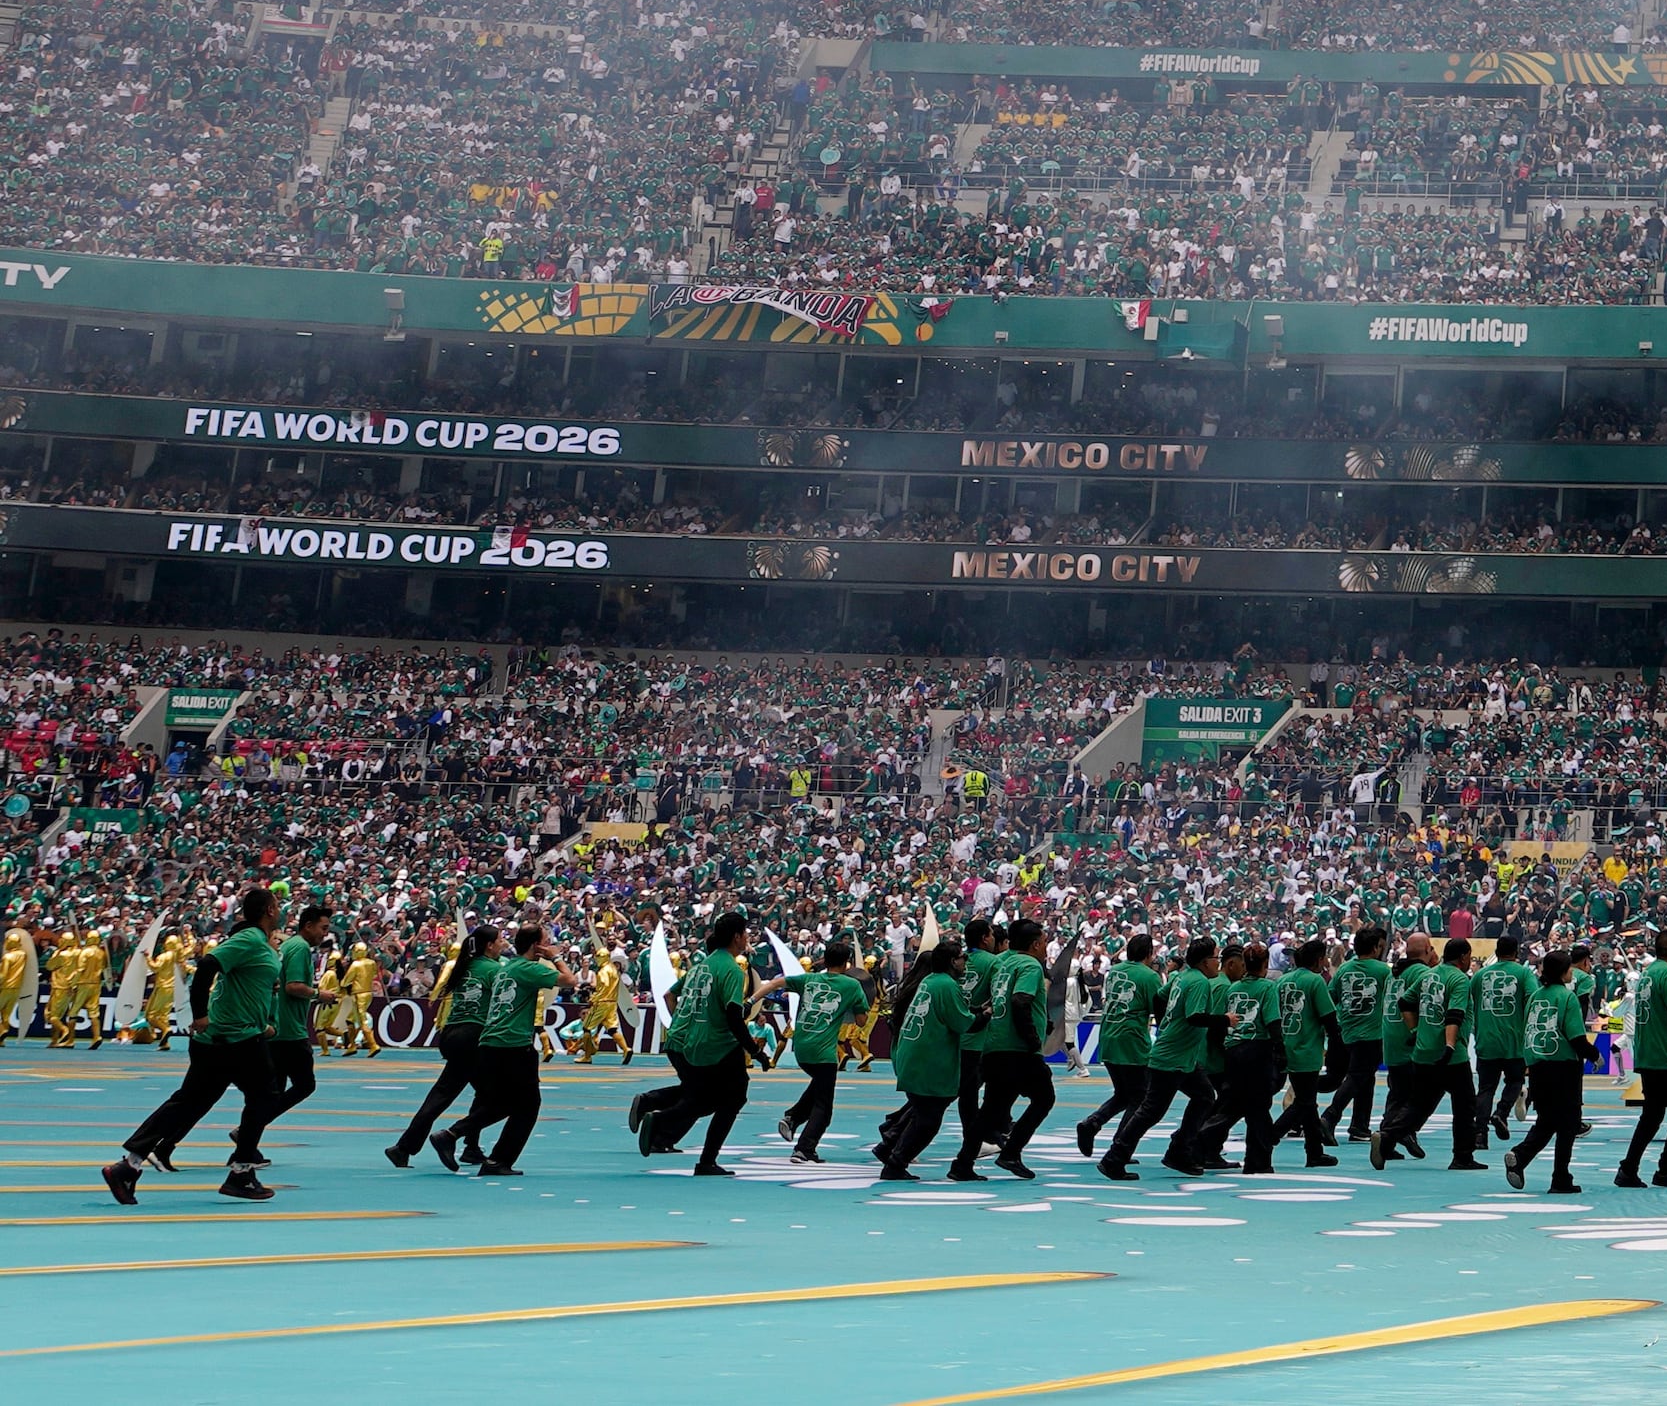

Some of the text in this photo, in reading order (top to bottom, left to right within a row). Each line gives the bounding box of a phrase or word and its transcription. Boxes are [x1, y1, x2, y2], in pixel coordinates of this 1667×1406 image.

[1140, 54, 1260, 76] #FIFAWorldCup
[648, 284, 693, 320] LA
[731, 286, 868, 335] BANDA
[1369, 317, 1528, 346] #FIFAWorldCup
[184, 407, 621, 455] FIFA WORLD CUP 2026
[961, 439, 1209, 472] MEXICO CITY
[258, 527, 394, 561] WORLD
[400, 536, 475, 567] CUP
[952, 551, 1200, 583] MEXICO CITY
[172, 696, 231, 709] SALIDA EXIT
[1180, 706, 1262, 723] SALIDA EXIT 3
[1360, 780, 1369, 791] 19
[94, 822, 122, 832] FIFA
